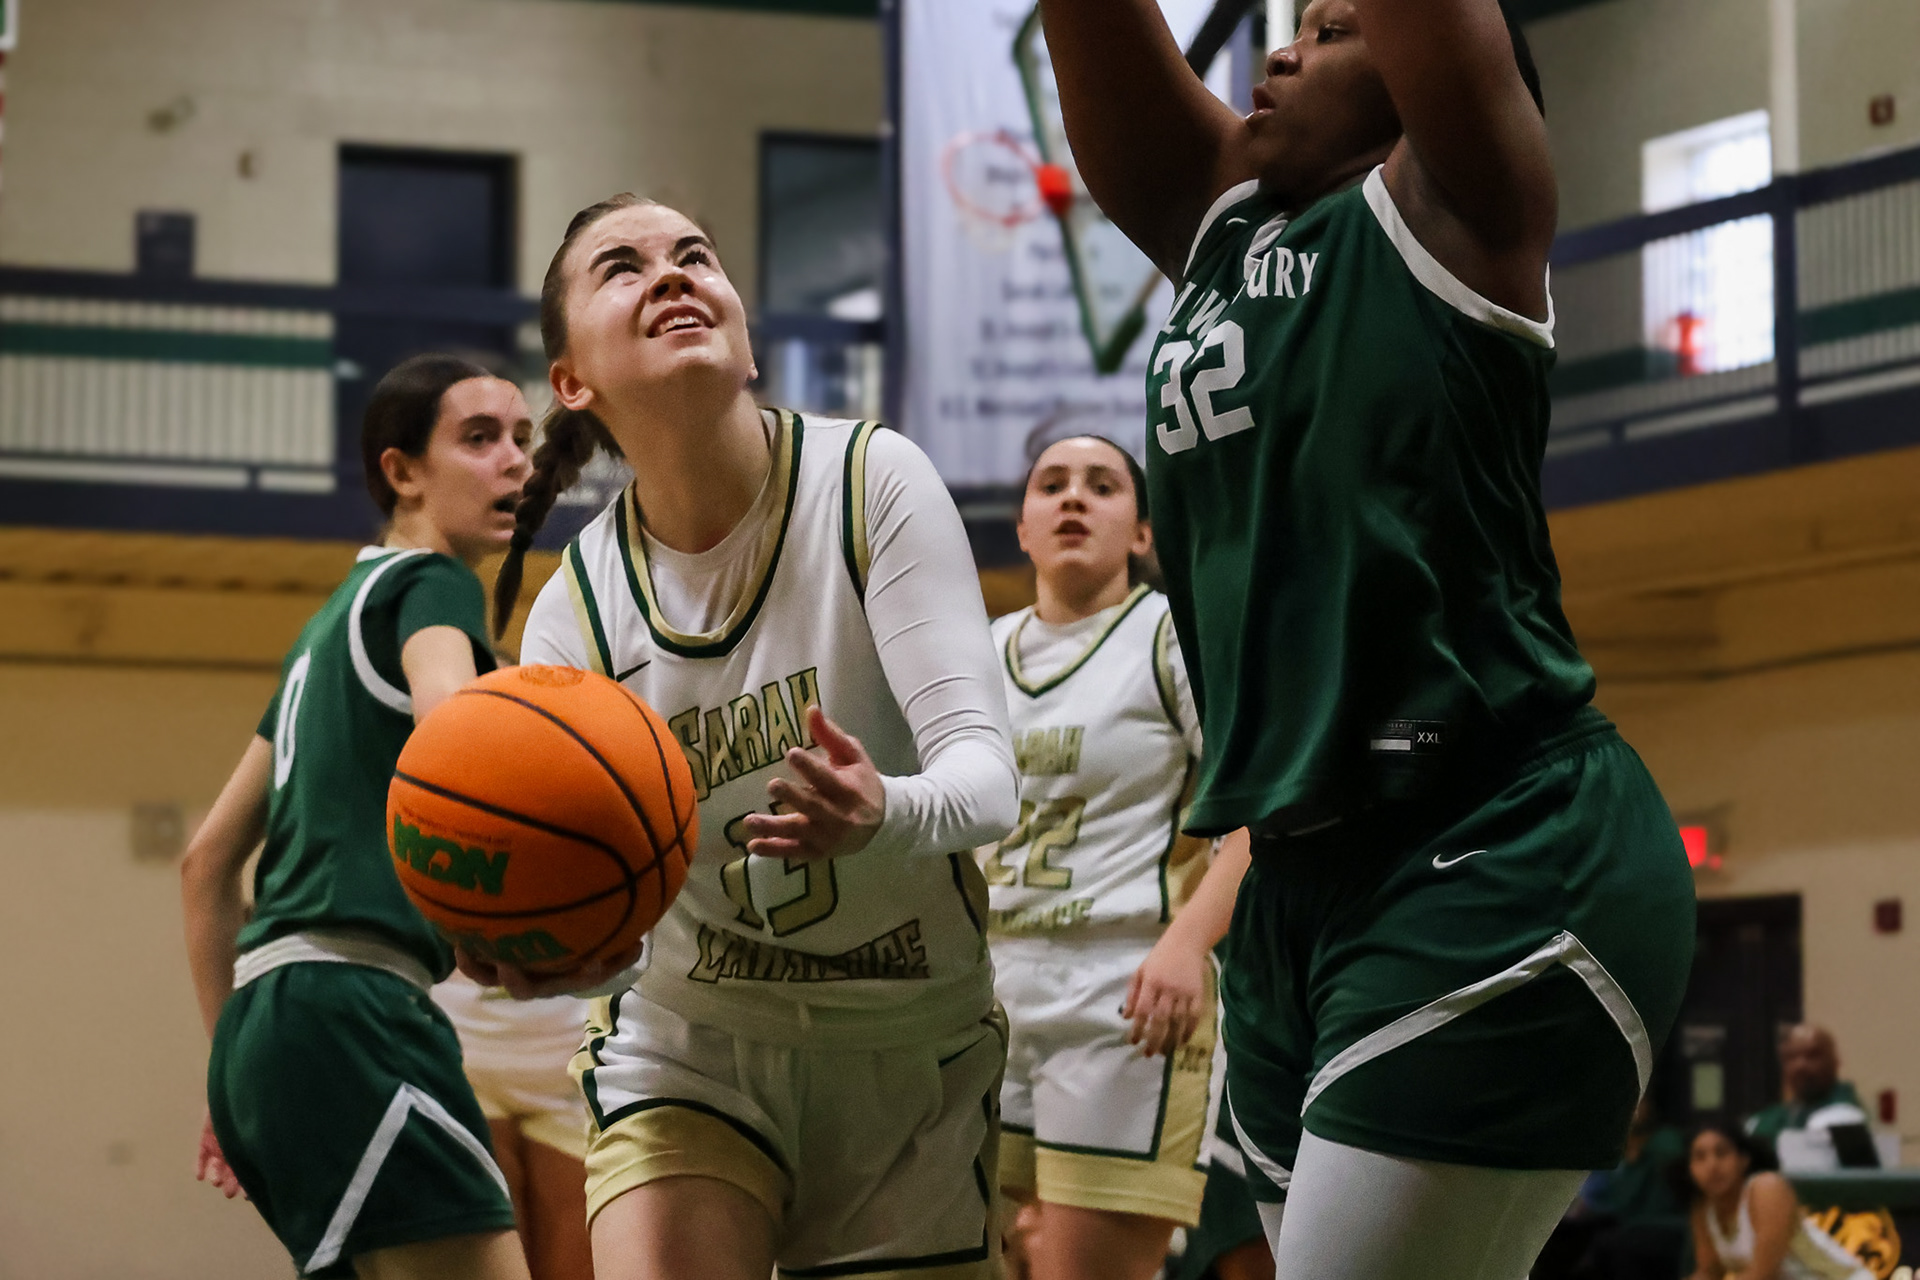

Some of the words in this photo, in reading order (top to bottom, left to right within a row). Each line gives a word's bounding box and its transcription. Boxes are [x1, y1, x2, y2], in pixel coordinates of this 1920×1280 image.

[1153, 320, 1255, 455] 32
[274, 648, 311, 791] 0
[668, 666, 821, 803] SARAH
[1417, 731, 1442, 744] XXL
[983, 797, 1087, 889] 22
